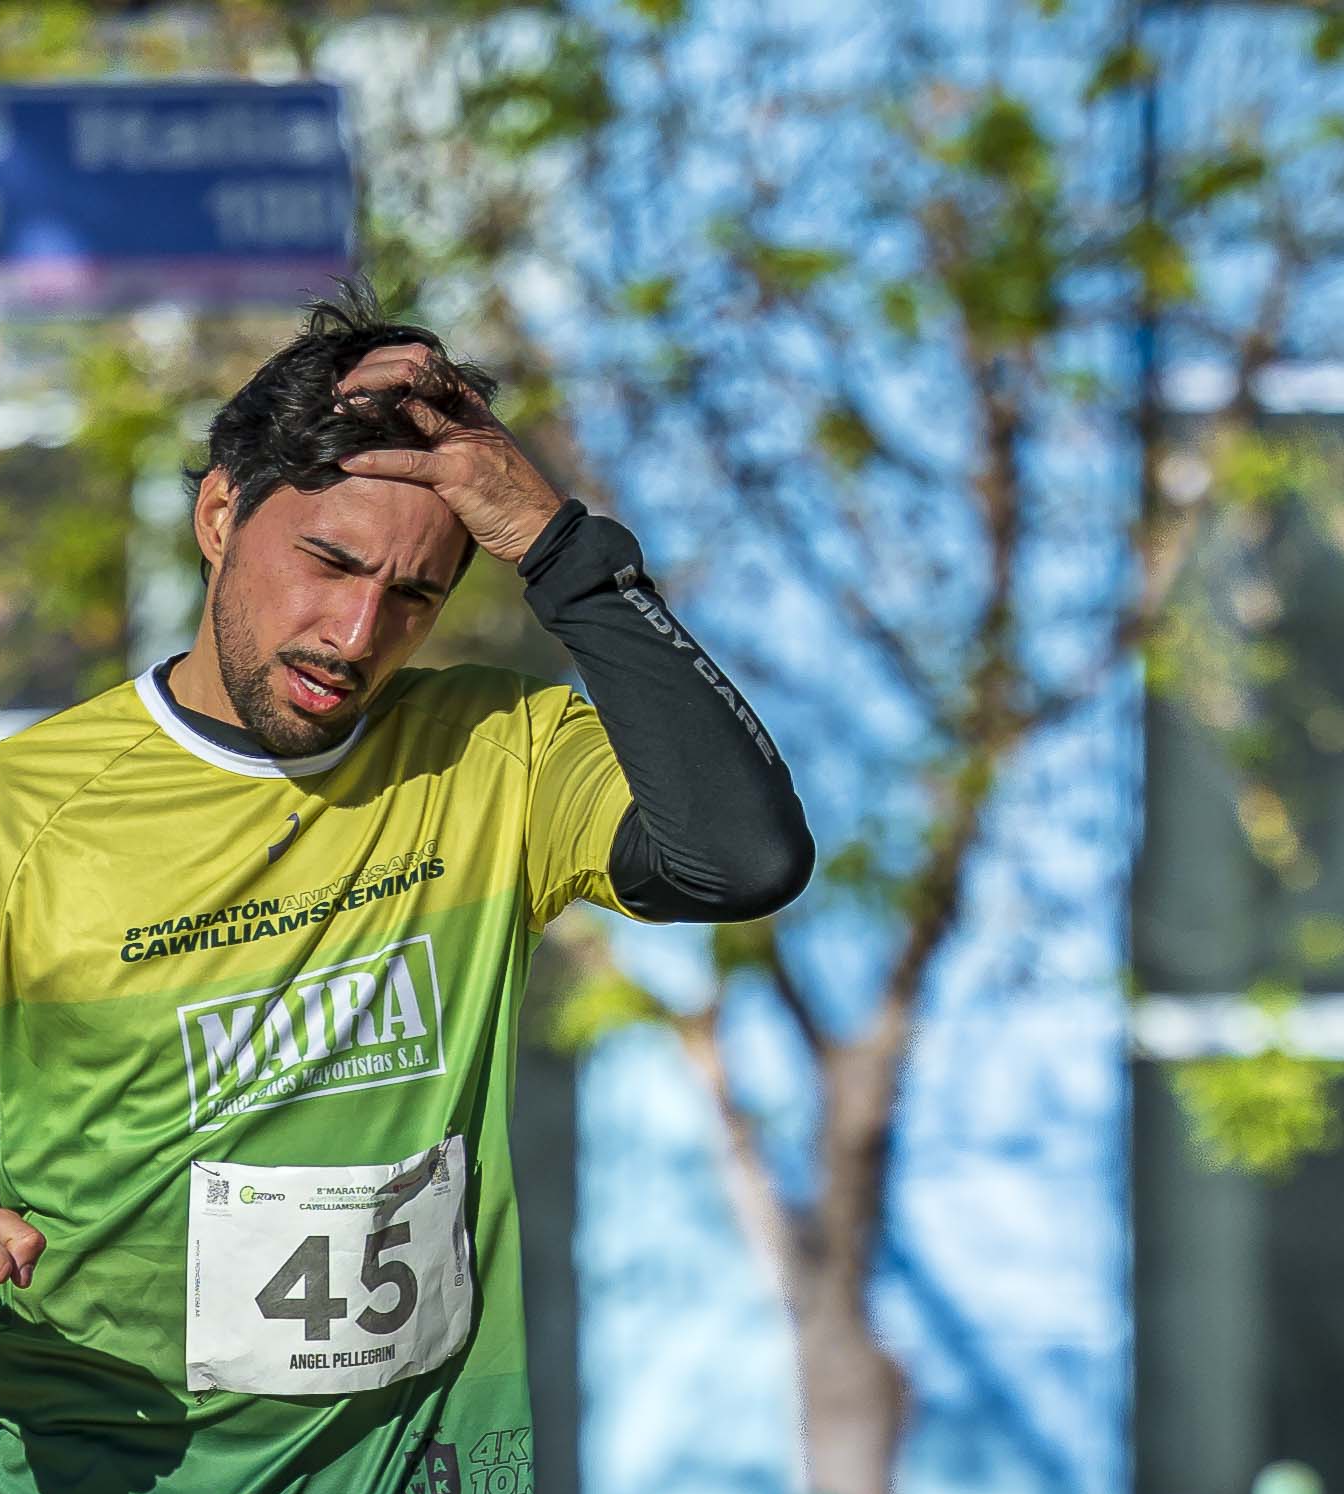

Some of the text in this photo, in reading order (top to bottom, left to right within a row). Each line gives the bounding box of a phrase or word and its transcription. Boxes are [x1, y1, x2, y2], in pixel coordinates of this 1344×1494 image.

[693, 656, 776, 766] CARE
[197, 954, 428, 1098] MAIRA
[397, 1044, 431, 1069] S.A.
[254, 1221, 419, 1342] 45
[289, 1344, 396, 1370] ANGEL PELLEGRINI
[468, 1426, 530, 1467] 4K
